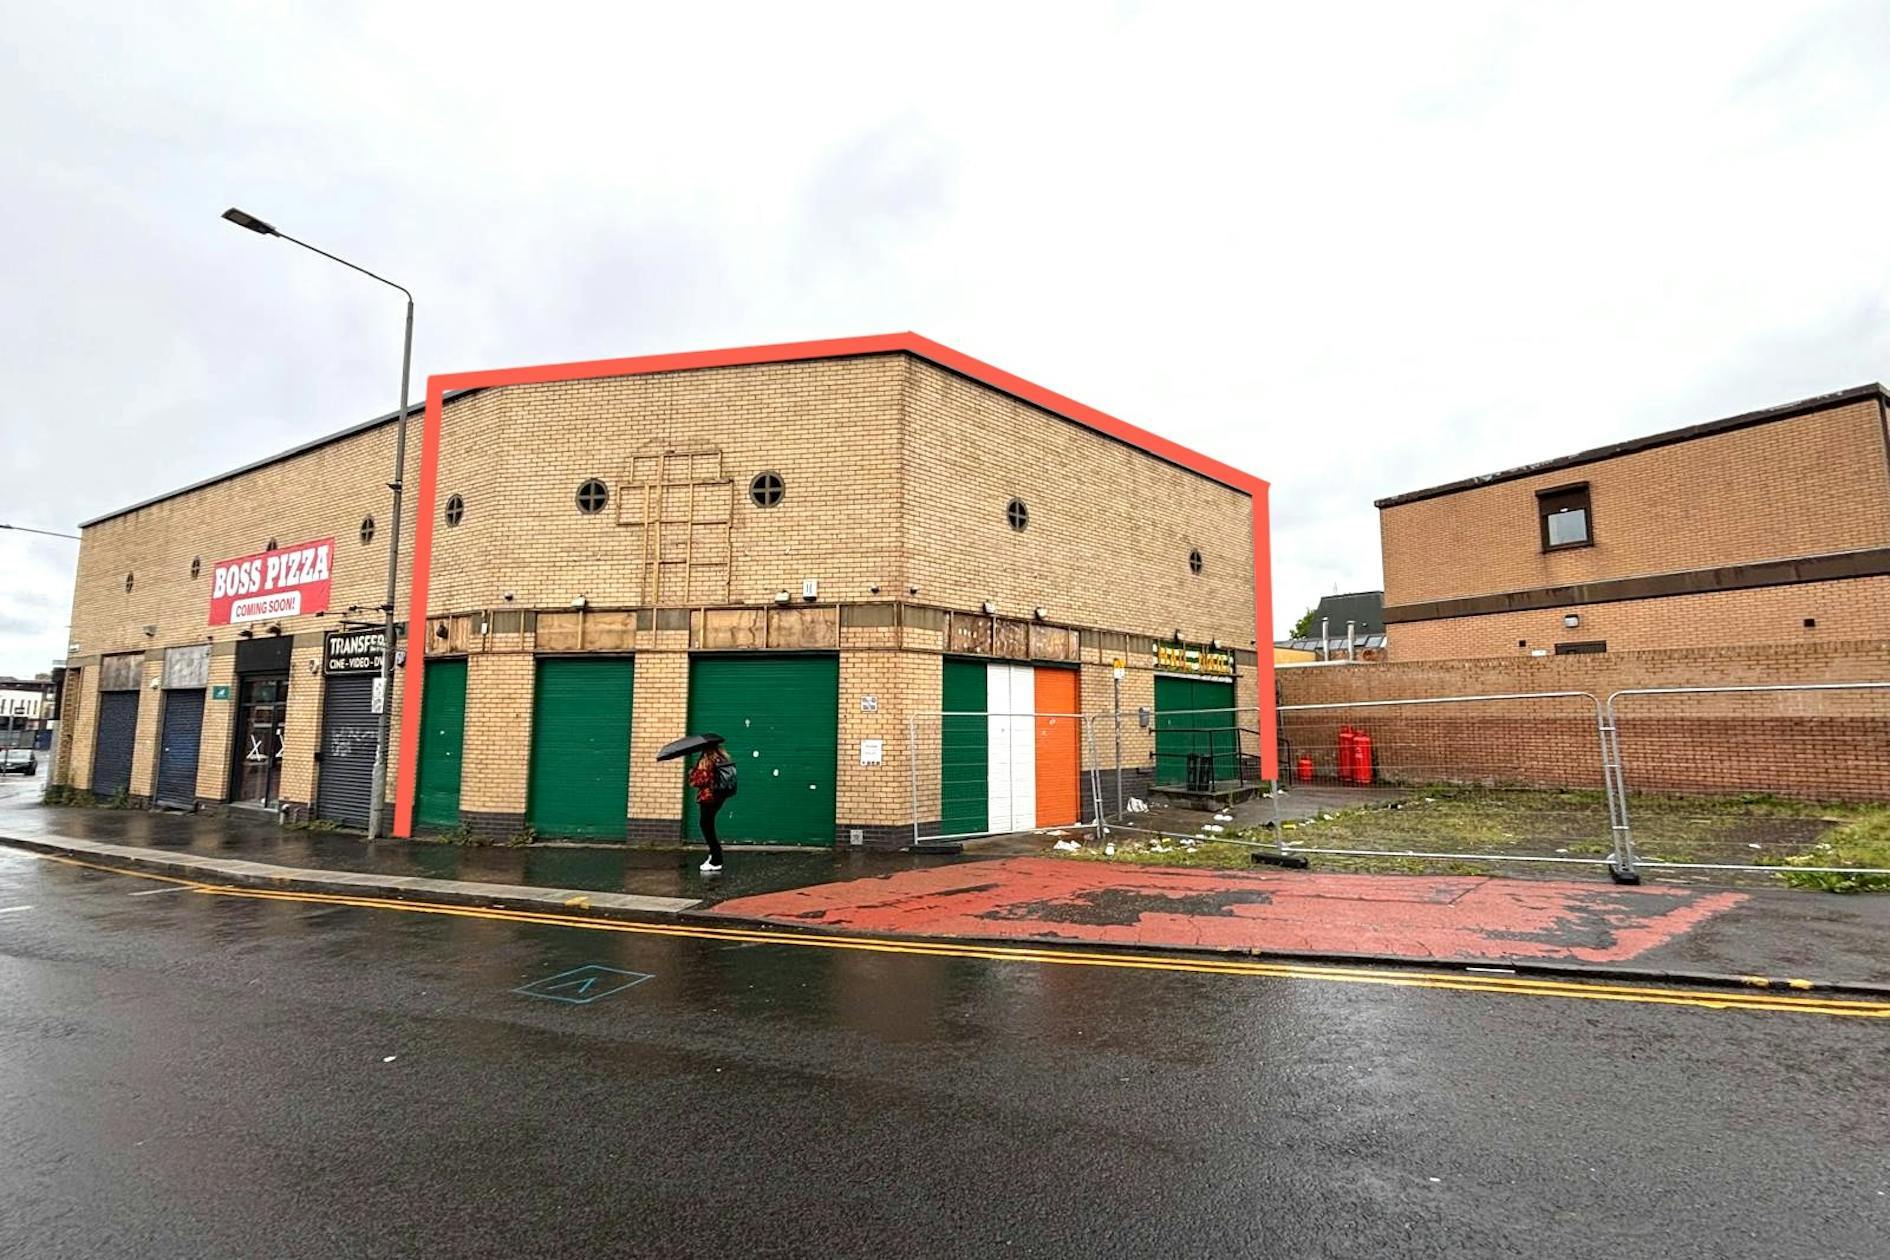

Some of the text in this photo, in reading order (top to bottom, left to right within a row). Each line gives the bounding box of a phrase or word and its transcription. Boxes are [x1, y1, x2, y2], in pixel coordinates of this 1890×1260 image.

[213, 545, 330, 599] BOSS PIZZA
[235, 597, 295, 618] COMING SOON!
